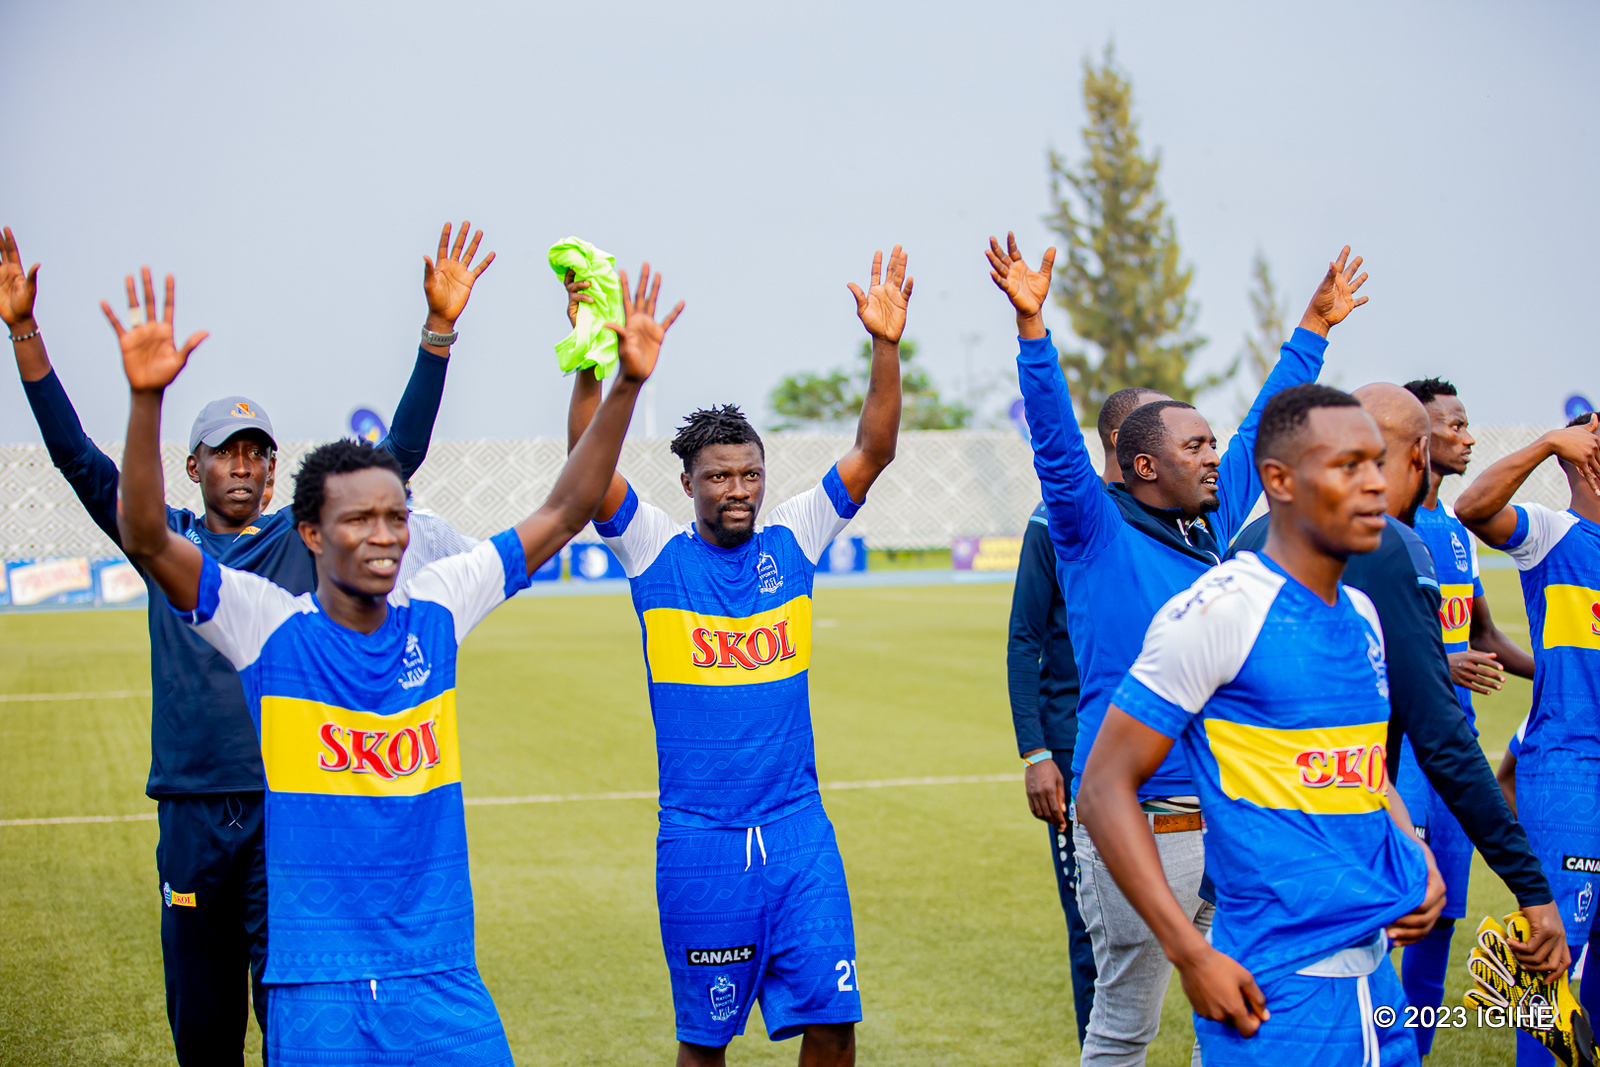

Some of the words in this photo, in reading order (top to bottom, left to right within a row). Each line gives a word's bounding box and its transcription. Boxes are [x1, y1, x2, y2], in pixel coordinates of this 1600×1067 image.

[184, 527, 203, 545] AKO
[691, 618, 797, 670] SKOL
[1293, 742, 1389, 797] SKO
[690, 947, 752, 964] CANAL+
